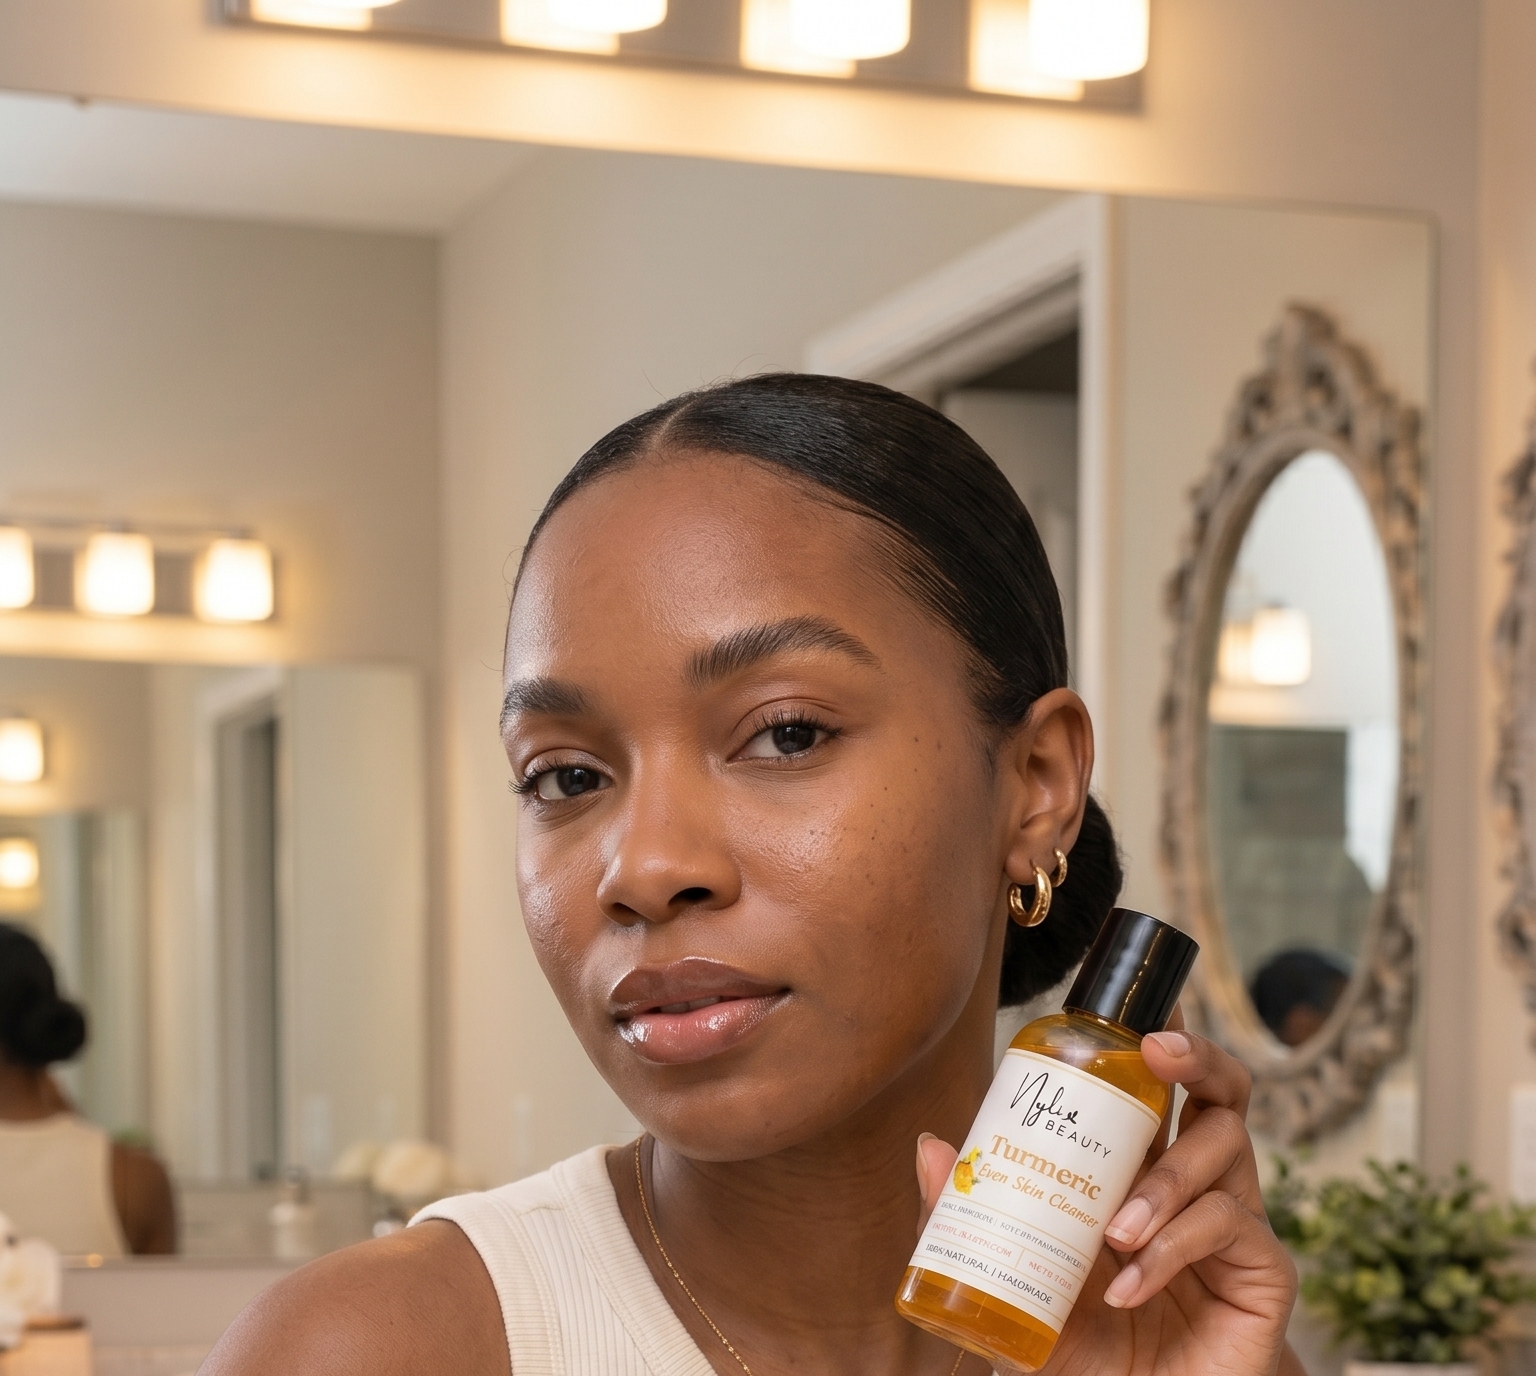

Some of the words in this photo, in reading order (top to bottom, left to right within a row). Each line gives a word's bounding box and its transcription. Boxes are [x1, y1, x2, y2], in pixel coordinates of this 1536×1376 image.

[989, 1134, 1102, 1201] Turmeric
[1045, 1119, 1112, 1159] BEAUTY
[978, 1162, 1009, 1184] Even
[1012, 1175, 1045, 1200] Skin
[1049, 1193, 1099, 1229] Cleanser
